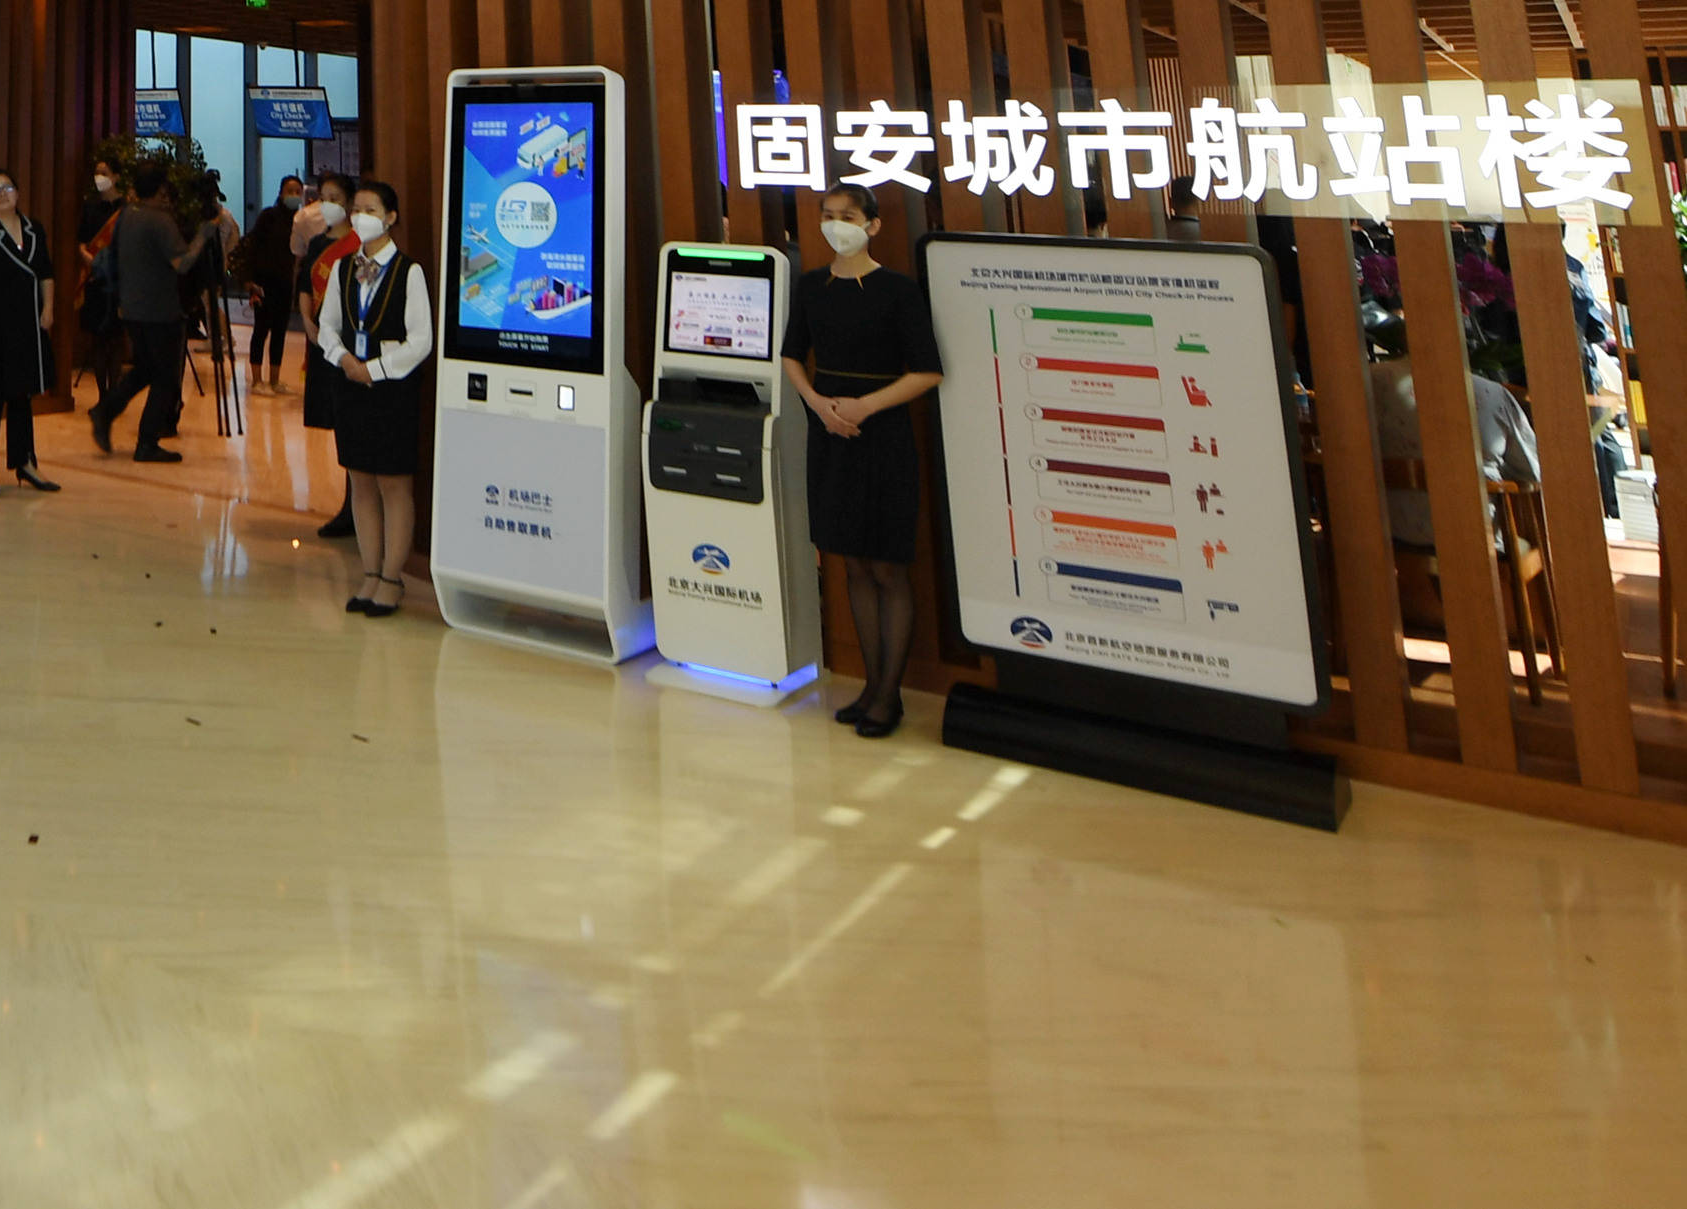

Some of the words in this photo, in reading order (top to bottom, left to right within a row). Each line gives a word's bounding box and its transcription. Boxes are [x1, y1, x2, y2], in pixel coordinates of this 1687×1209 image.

[736, 94, 1633, 210] 固安城市航站楼
[960, 280, 989, 291] Beijing
[989, 281, 1018, 292] Daxing
[1019, 283, 1072, 293] International
[1073, 286, 1103, 297] Airport
[1135, 289, 1153, 300] City
[1154, 290, 1196, 302] Check-in
[1196, 293, 1235, 303] Process
[509, 488, 553, 507] 机场巴士
